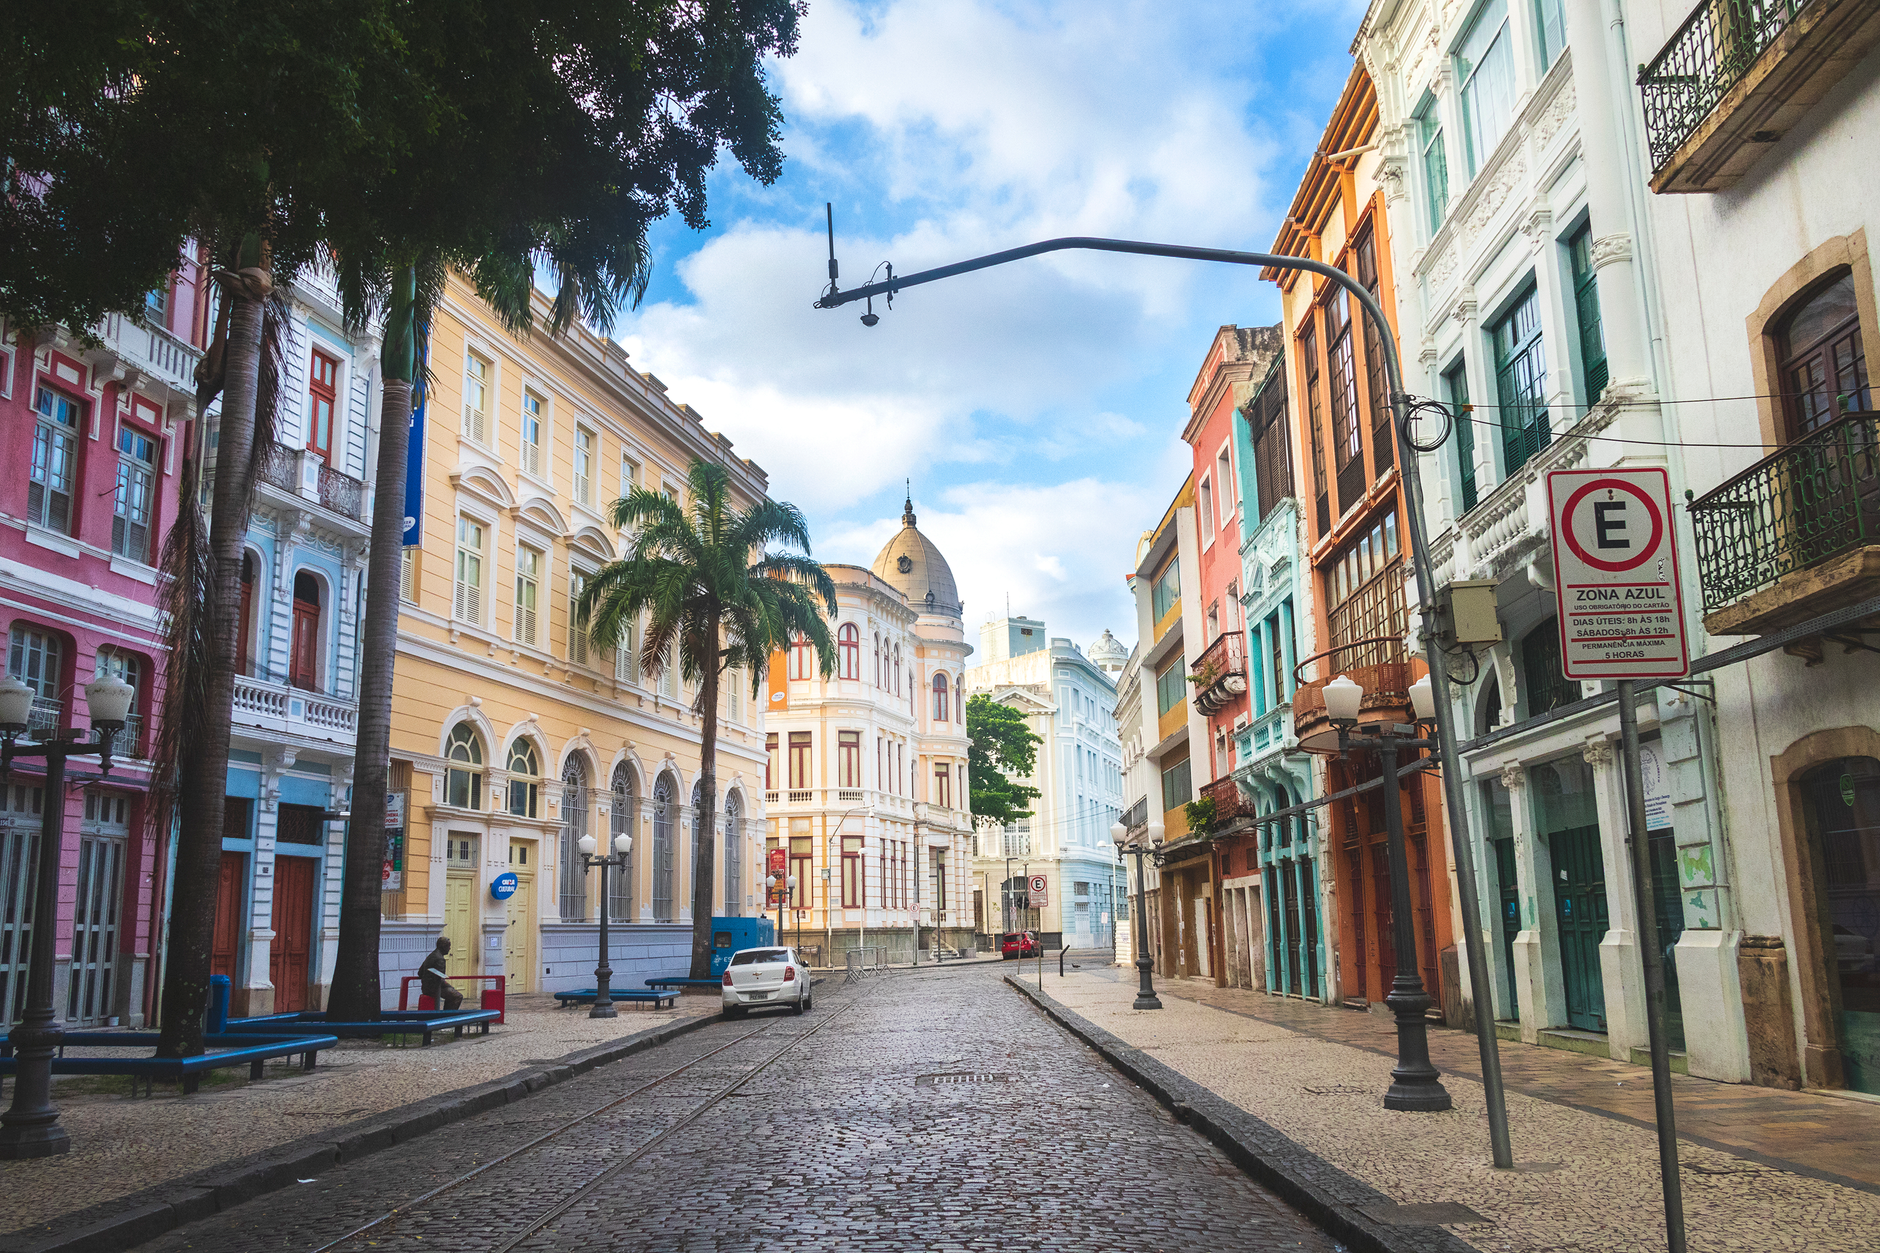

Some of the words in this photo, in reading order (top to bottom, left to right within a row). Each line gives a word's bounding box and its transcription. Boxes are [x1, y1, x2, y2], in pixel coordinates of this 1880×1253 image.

[1593, 501, 1631, 549] E
[1576, 588, 1620, 601] ZONA
[1624, 587, 1666, 600] AZUL
[1588, 602, 1632, 610] OBRIGATÓRIO
[1573, 618, 1594, 626] DIAS
[1596, 616, 1626, 626] ÚTEIS:
[1627, 616, 1638, 625] 8h
[1639, 614, 1653, 624] ÀS
[1654, 615, 1670, 623] 18h
[1625, 628, 1637, 636] 8h
[1638, 626, 1651, 635] ÀS
[1653, 626, 1669, 635] 12h
[1582, 640, 1635, 650] PERMANÊNCIA
[1636, 639, 1666, 647] MÁXIMA
[1605, 651, 1611, 659] 5
[1612, 650, 1645, 658] HORAS
[498, 885, 515, 893] CULTURAL
[1035, 879, 1042, 889] E
